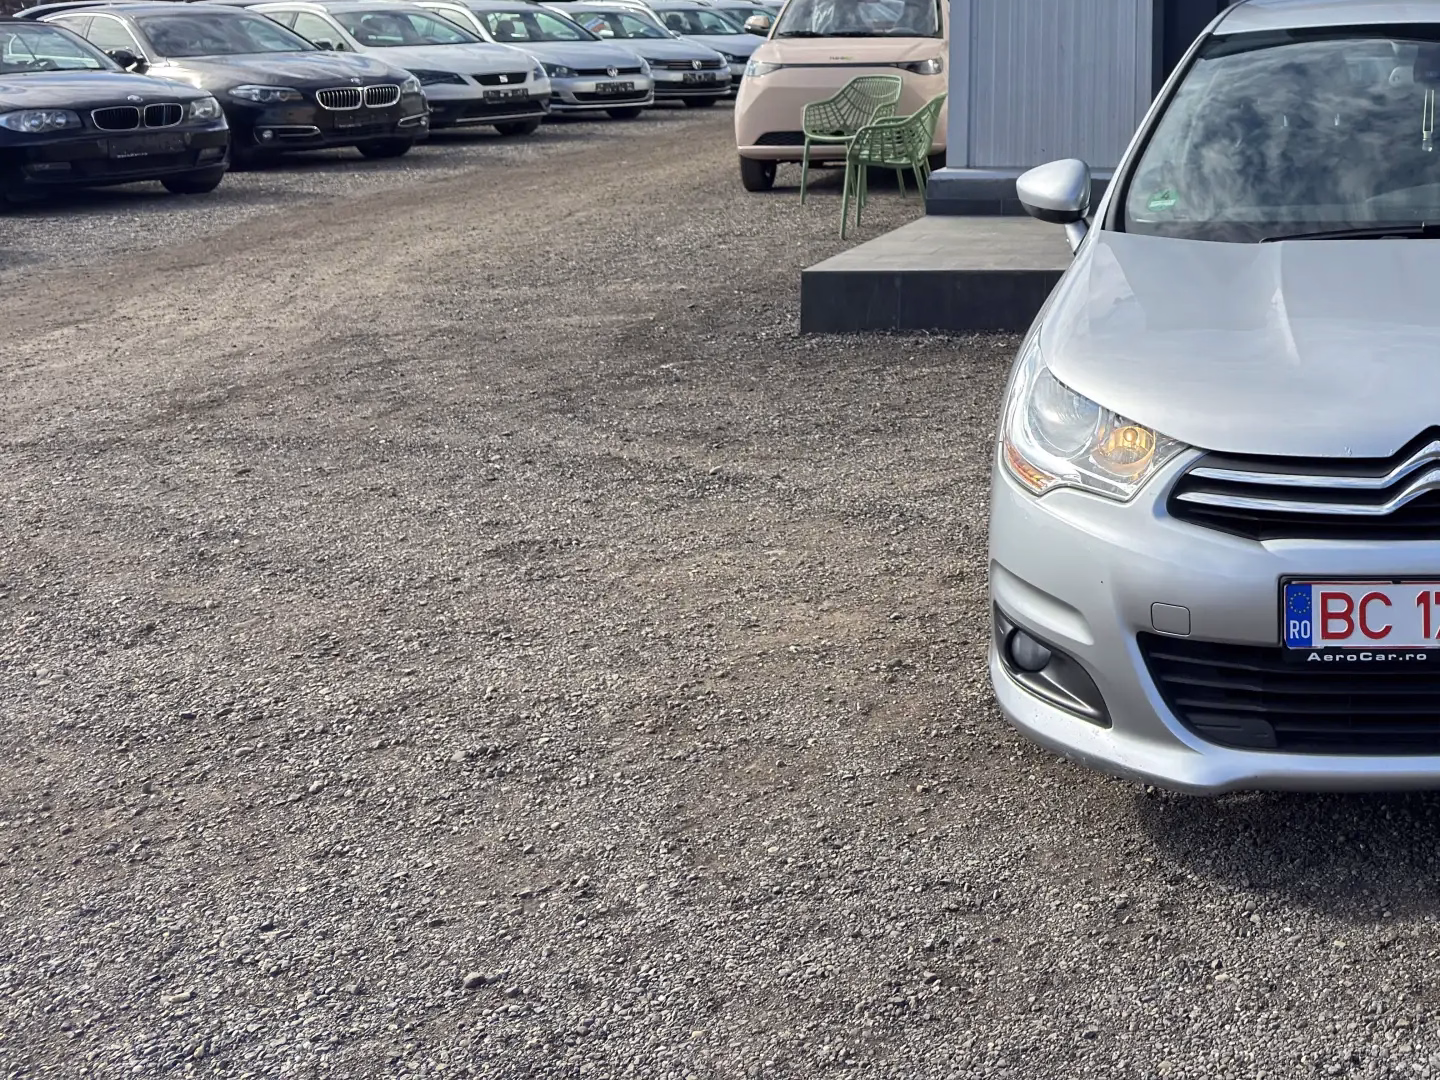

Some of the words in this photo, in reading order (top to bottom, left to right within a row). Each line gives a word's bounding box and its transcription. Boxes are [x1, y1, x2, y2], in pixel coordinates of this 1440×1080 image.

[1320, 591, 1393, 640] BC
[1289, 620, 1311, 639] RO
[1307, 651, 1428, 662] AeroCar.ro
